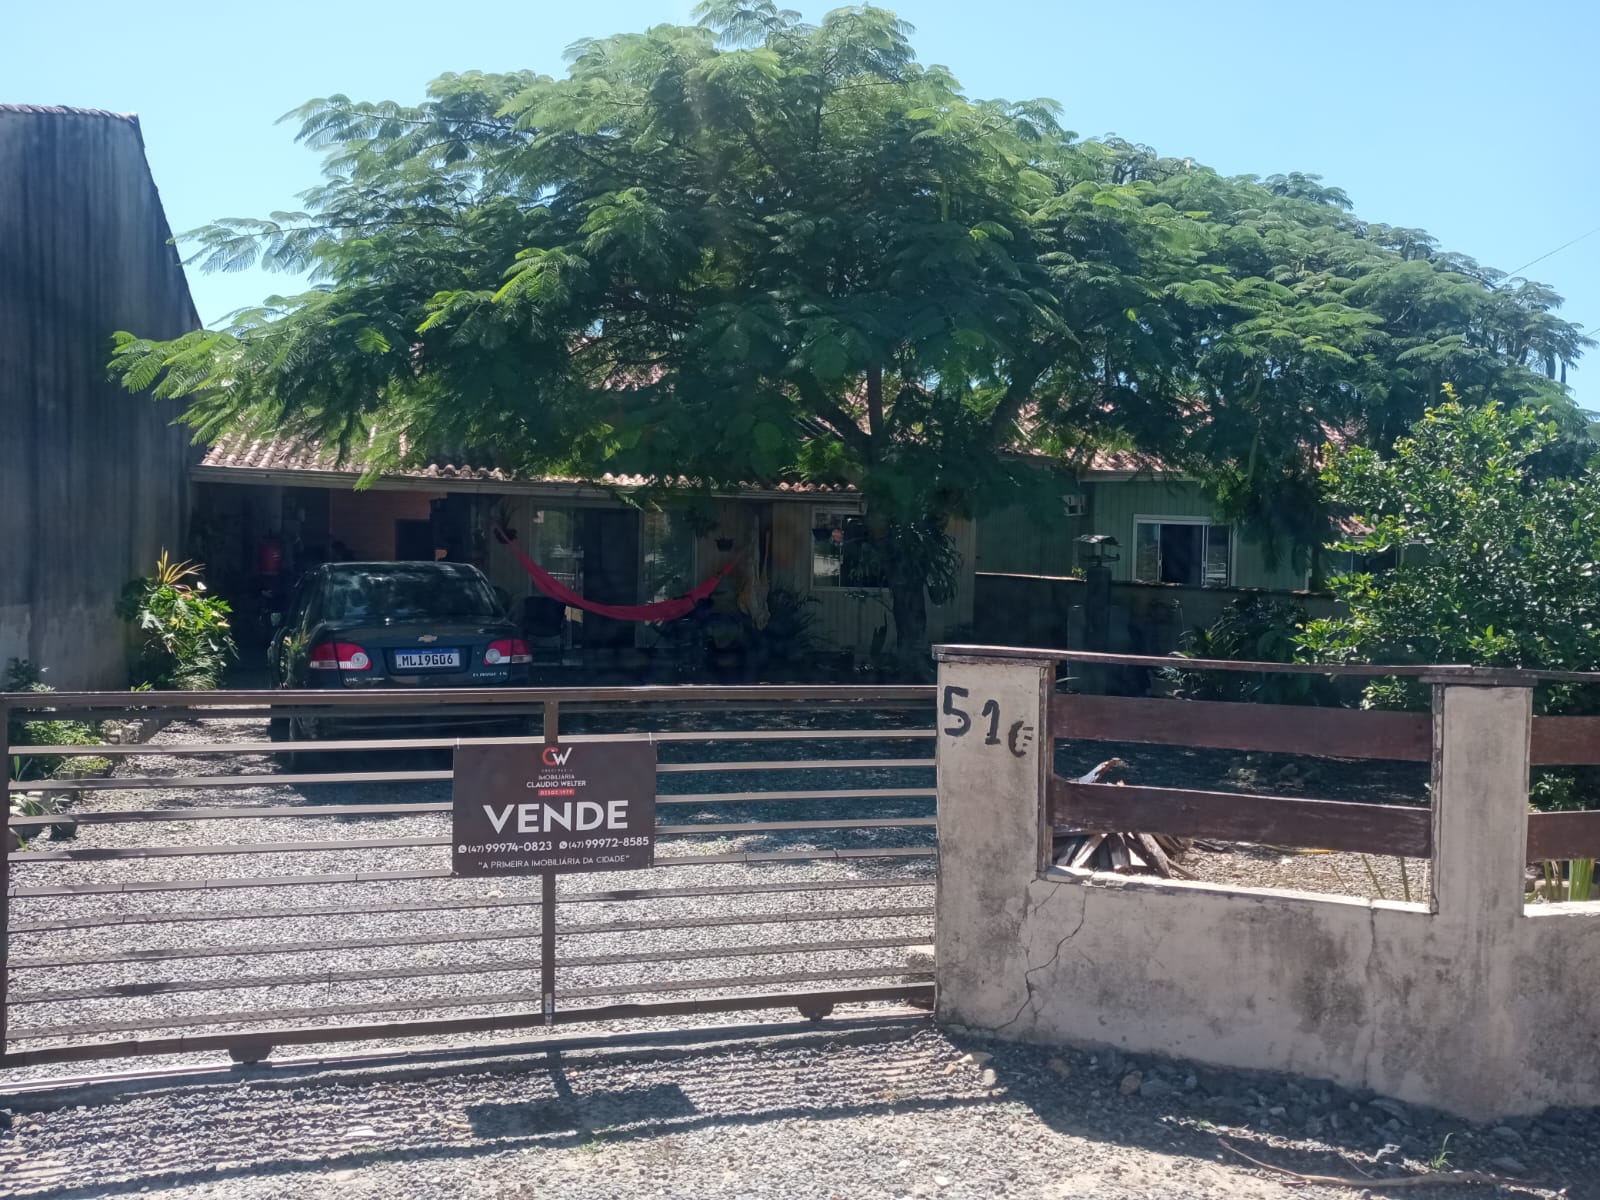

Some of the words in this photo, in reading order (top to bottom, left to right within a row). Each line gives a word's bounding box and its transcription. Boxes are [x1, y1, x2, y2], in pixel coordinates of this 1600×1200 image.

[482, 800, 629, 834] VENDE
[467, 844, 485, 853] (47)
[485, 841, 552, 853] 99974-0823
[568, 841, 584, 849] (47)
[585, 836, 649, 849] 99972-8585
[490, 860, 529, 869] PRIMEIRA
[583, 857, 593, 865] DA
